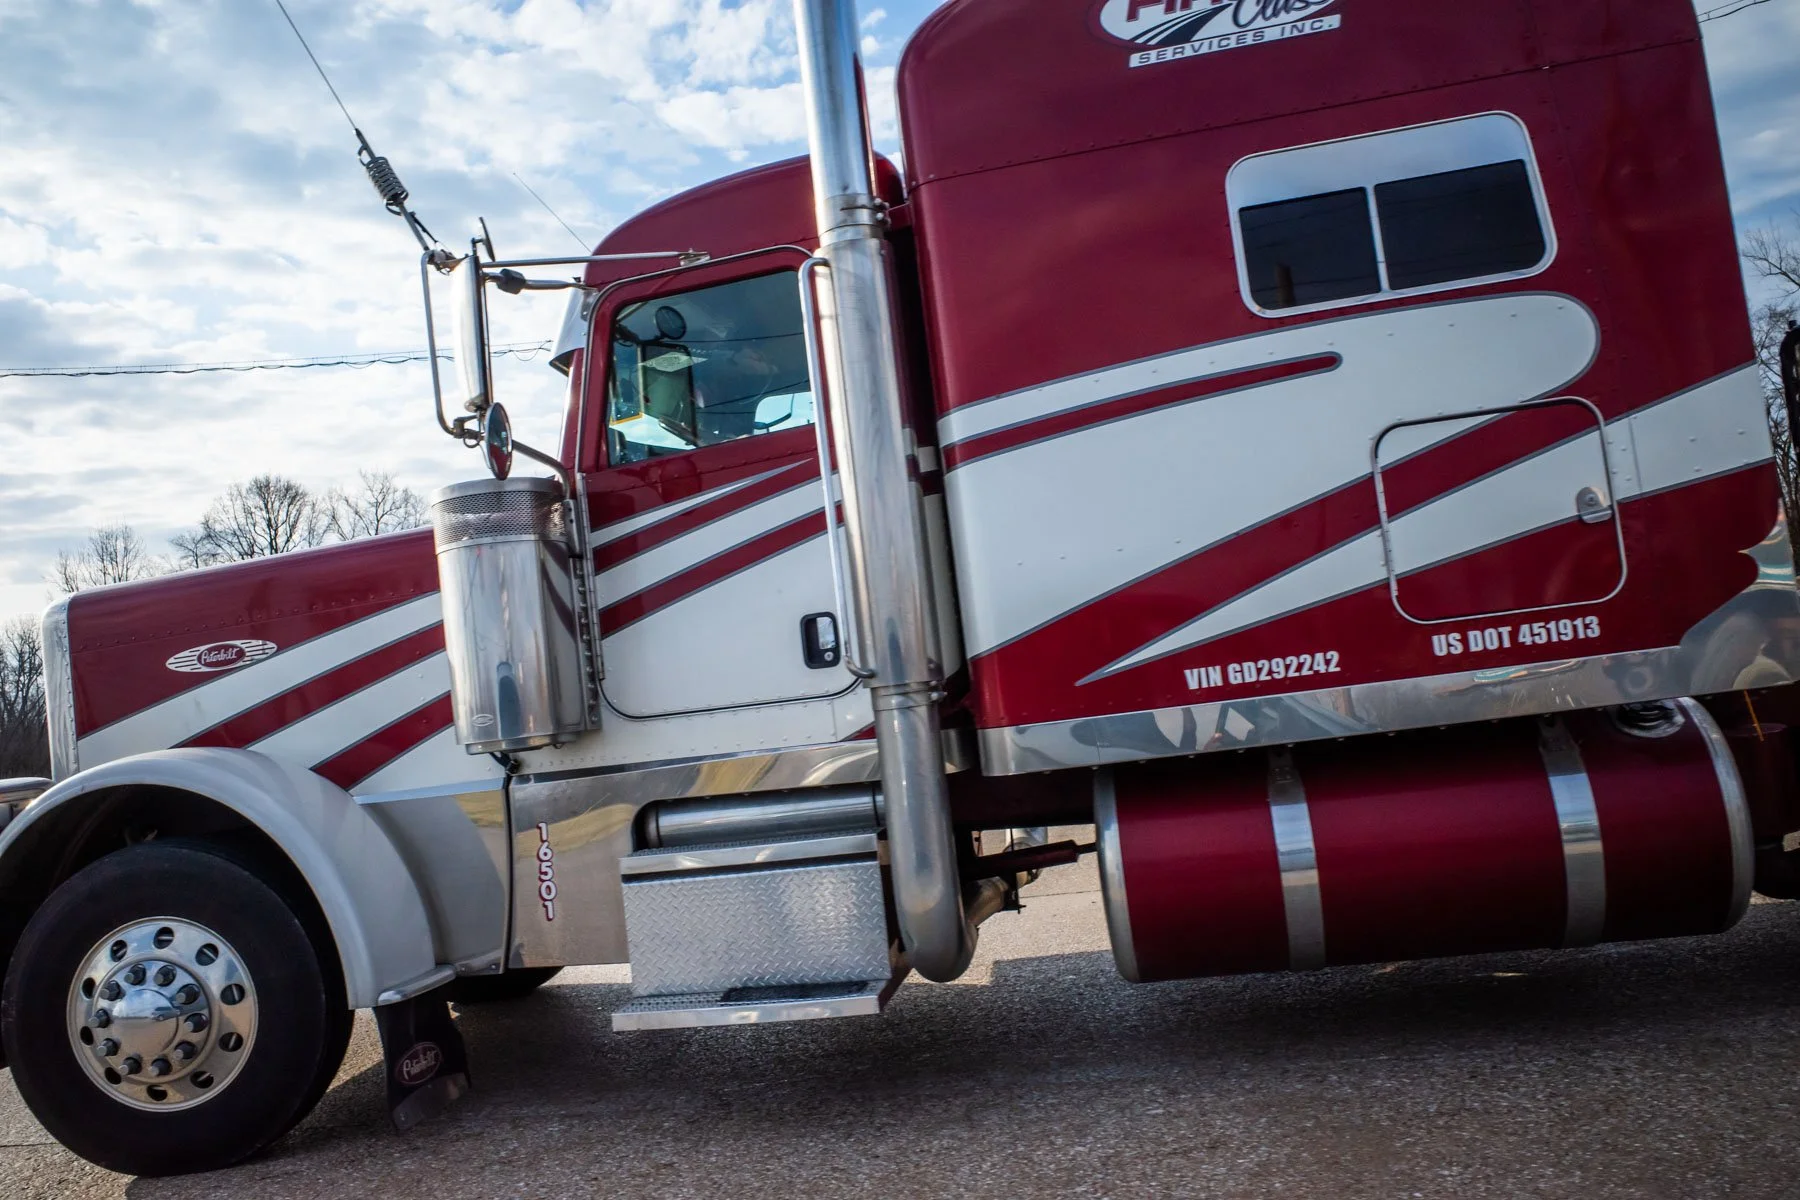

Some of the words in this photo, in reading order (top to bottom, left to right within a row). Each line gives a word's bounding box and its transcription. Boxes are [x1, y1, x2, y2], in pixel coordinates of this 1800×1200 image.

[1138, 30, 1265, 64] SERVICES
[1280, 19, 1333, 37] INC.
[1431, 632, 1464, 656] US
[1467, 626, 1512, 652] DOT
[1517, 615, 1600, 645] 451913
[1184, 665, 1223, 690] VIN
[1227, 650, 1341, 685] GD292242
[537, 822, 557, 921] 16501
